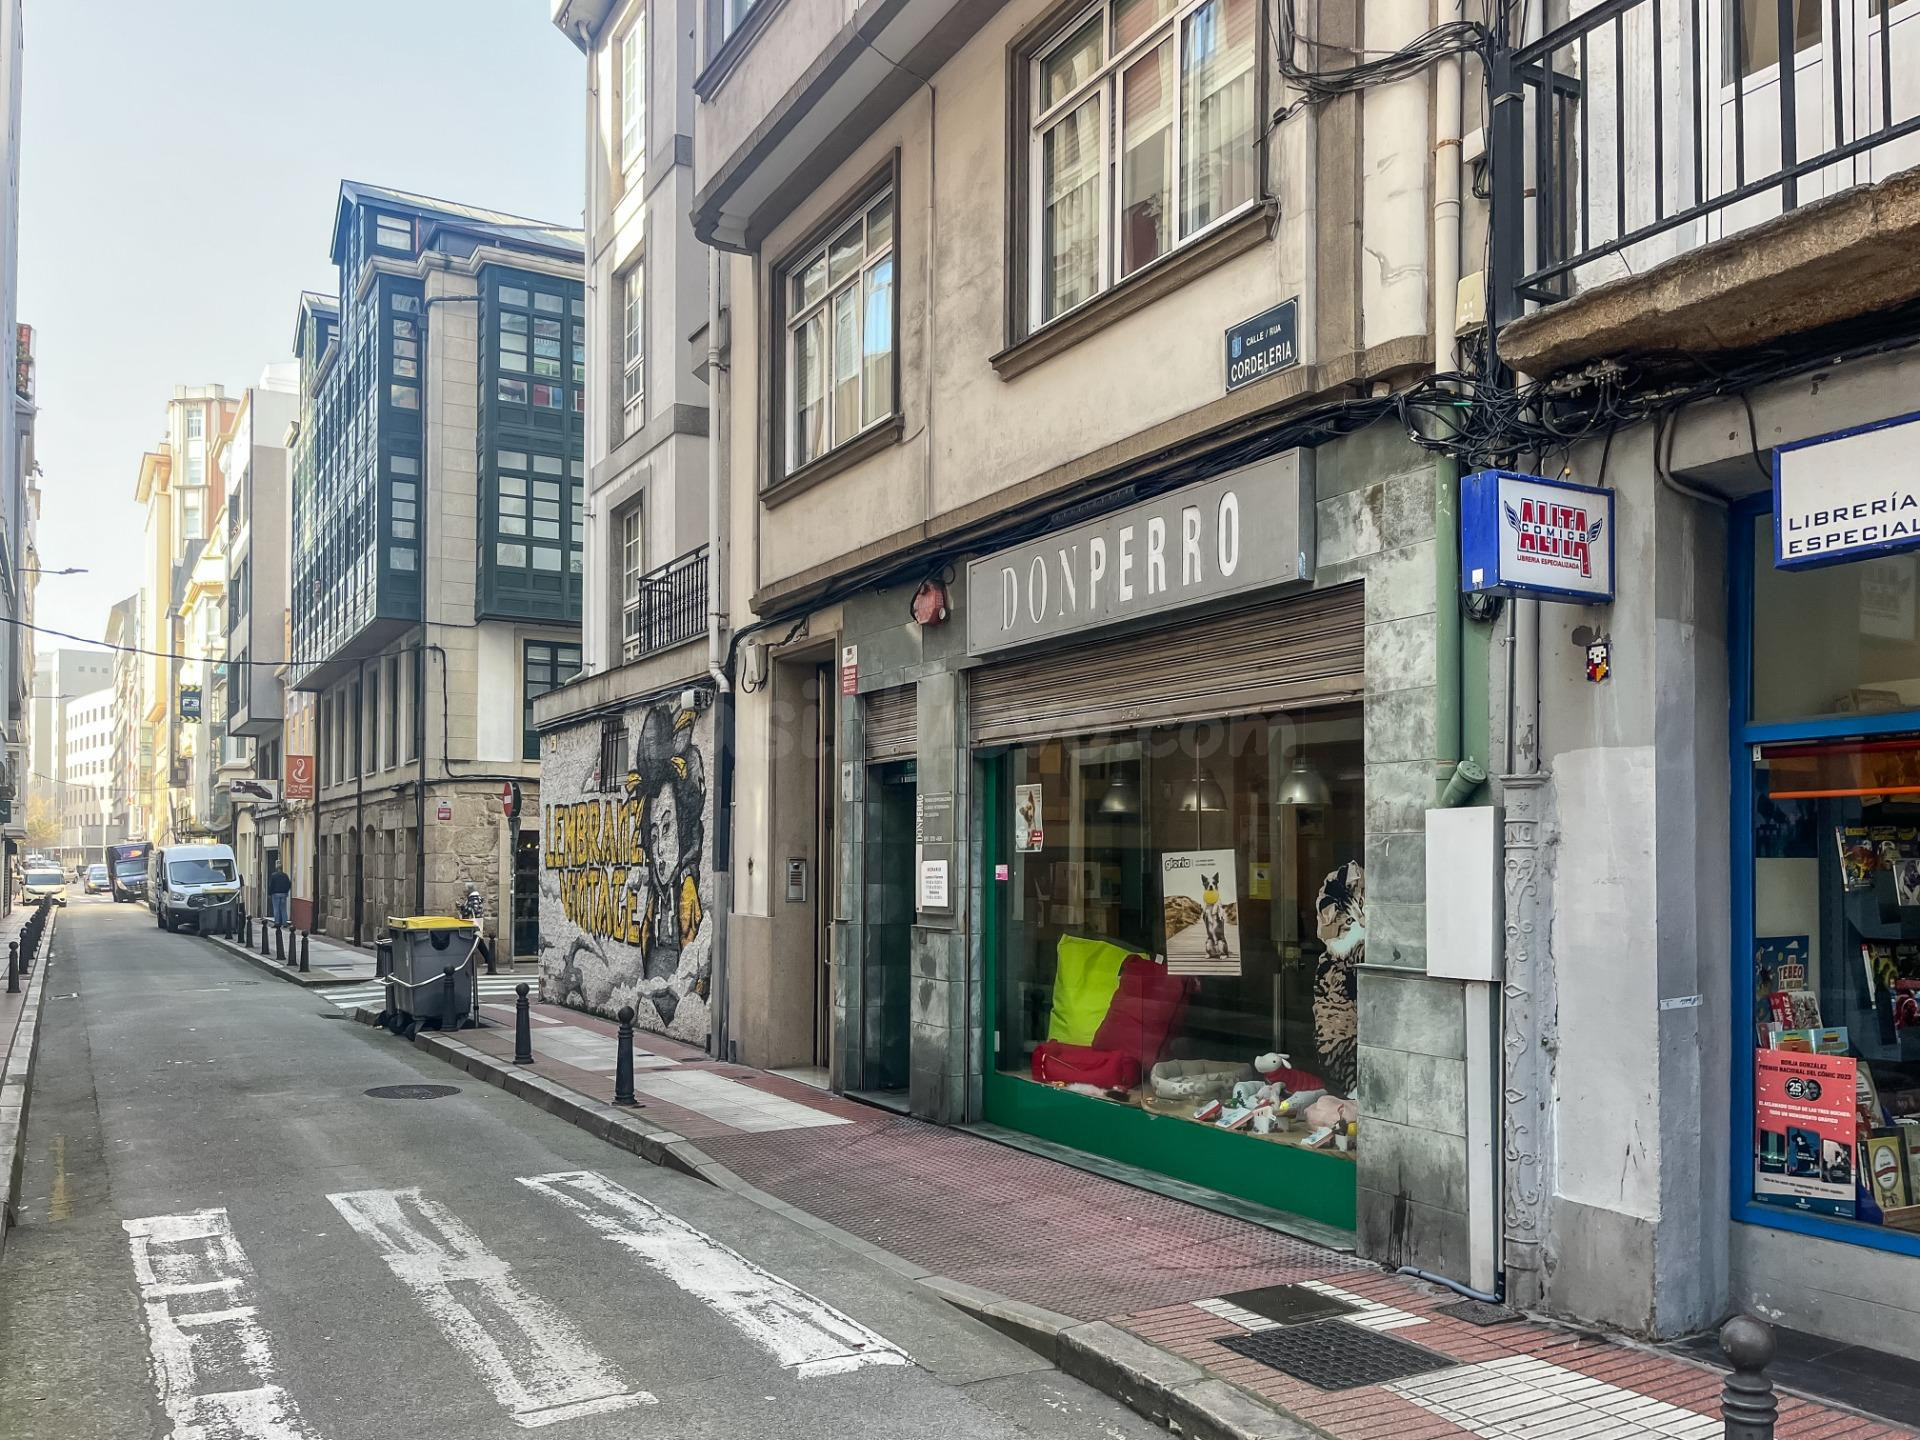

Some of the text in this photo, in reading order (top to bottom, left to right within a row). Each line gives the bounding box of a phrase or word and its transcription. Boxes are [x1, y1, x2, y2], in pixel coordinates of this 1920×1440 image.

[1246, 331, 1264, 346] CALLE
[1231, 340, 1292, 382] CORDELERIA
[1789, 491, 1918, 531] LIBRERÍA
[1518, 498, 1591, 578] ALITA
[1521, 523, 1586, 542] COMICS
[1789, 518, 1920, 554] ESPECIAL
[1541, 558, 1580, 570] ESPECIALIZADA
[1165, 857, 1191, 871] gloria
[1789, 1083, 1801, 1092] 25
